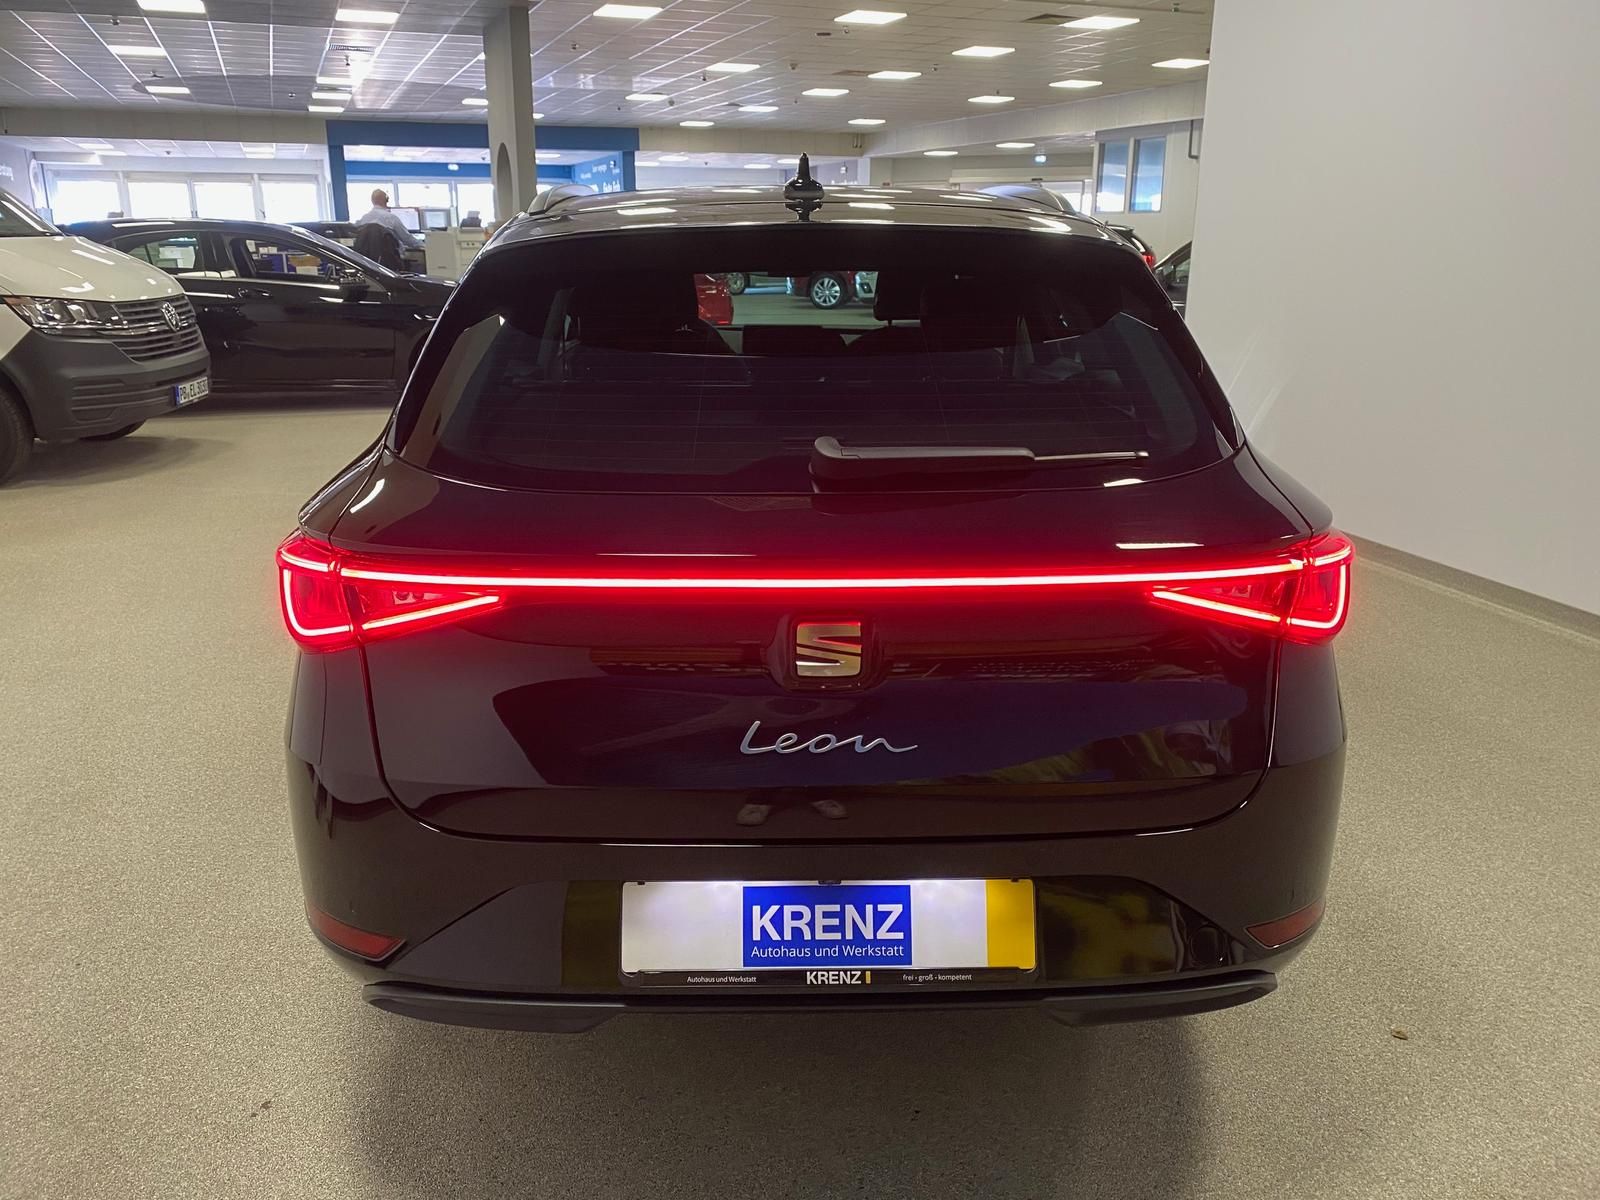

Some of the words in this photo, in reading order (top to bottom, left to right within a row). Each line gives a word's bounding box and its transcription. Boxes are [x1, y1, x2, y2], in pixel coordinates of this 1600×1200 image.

[739, 720, 919, 755] Leon
[752, 904, 905, 941] KRENZ
[751, 946, 811, 958] Autohaus
[814, 945, 839, 957] und
[842, 945, 905, 957] Werkstatt
[687, 975, 715, 983] Autohaus
[716, 975, 728, 983] und
[728, 975, 757, 983] Werkstatt
[806, 971, 862, 985] KRENZ
[902, 974, 914, 982] frei
[918, 974, 934, 983] groß
[937, 974, 972, 982] kompetent
